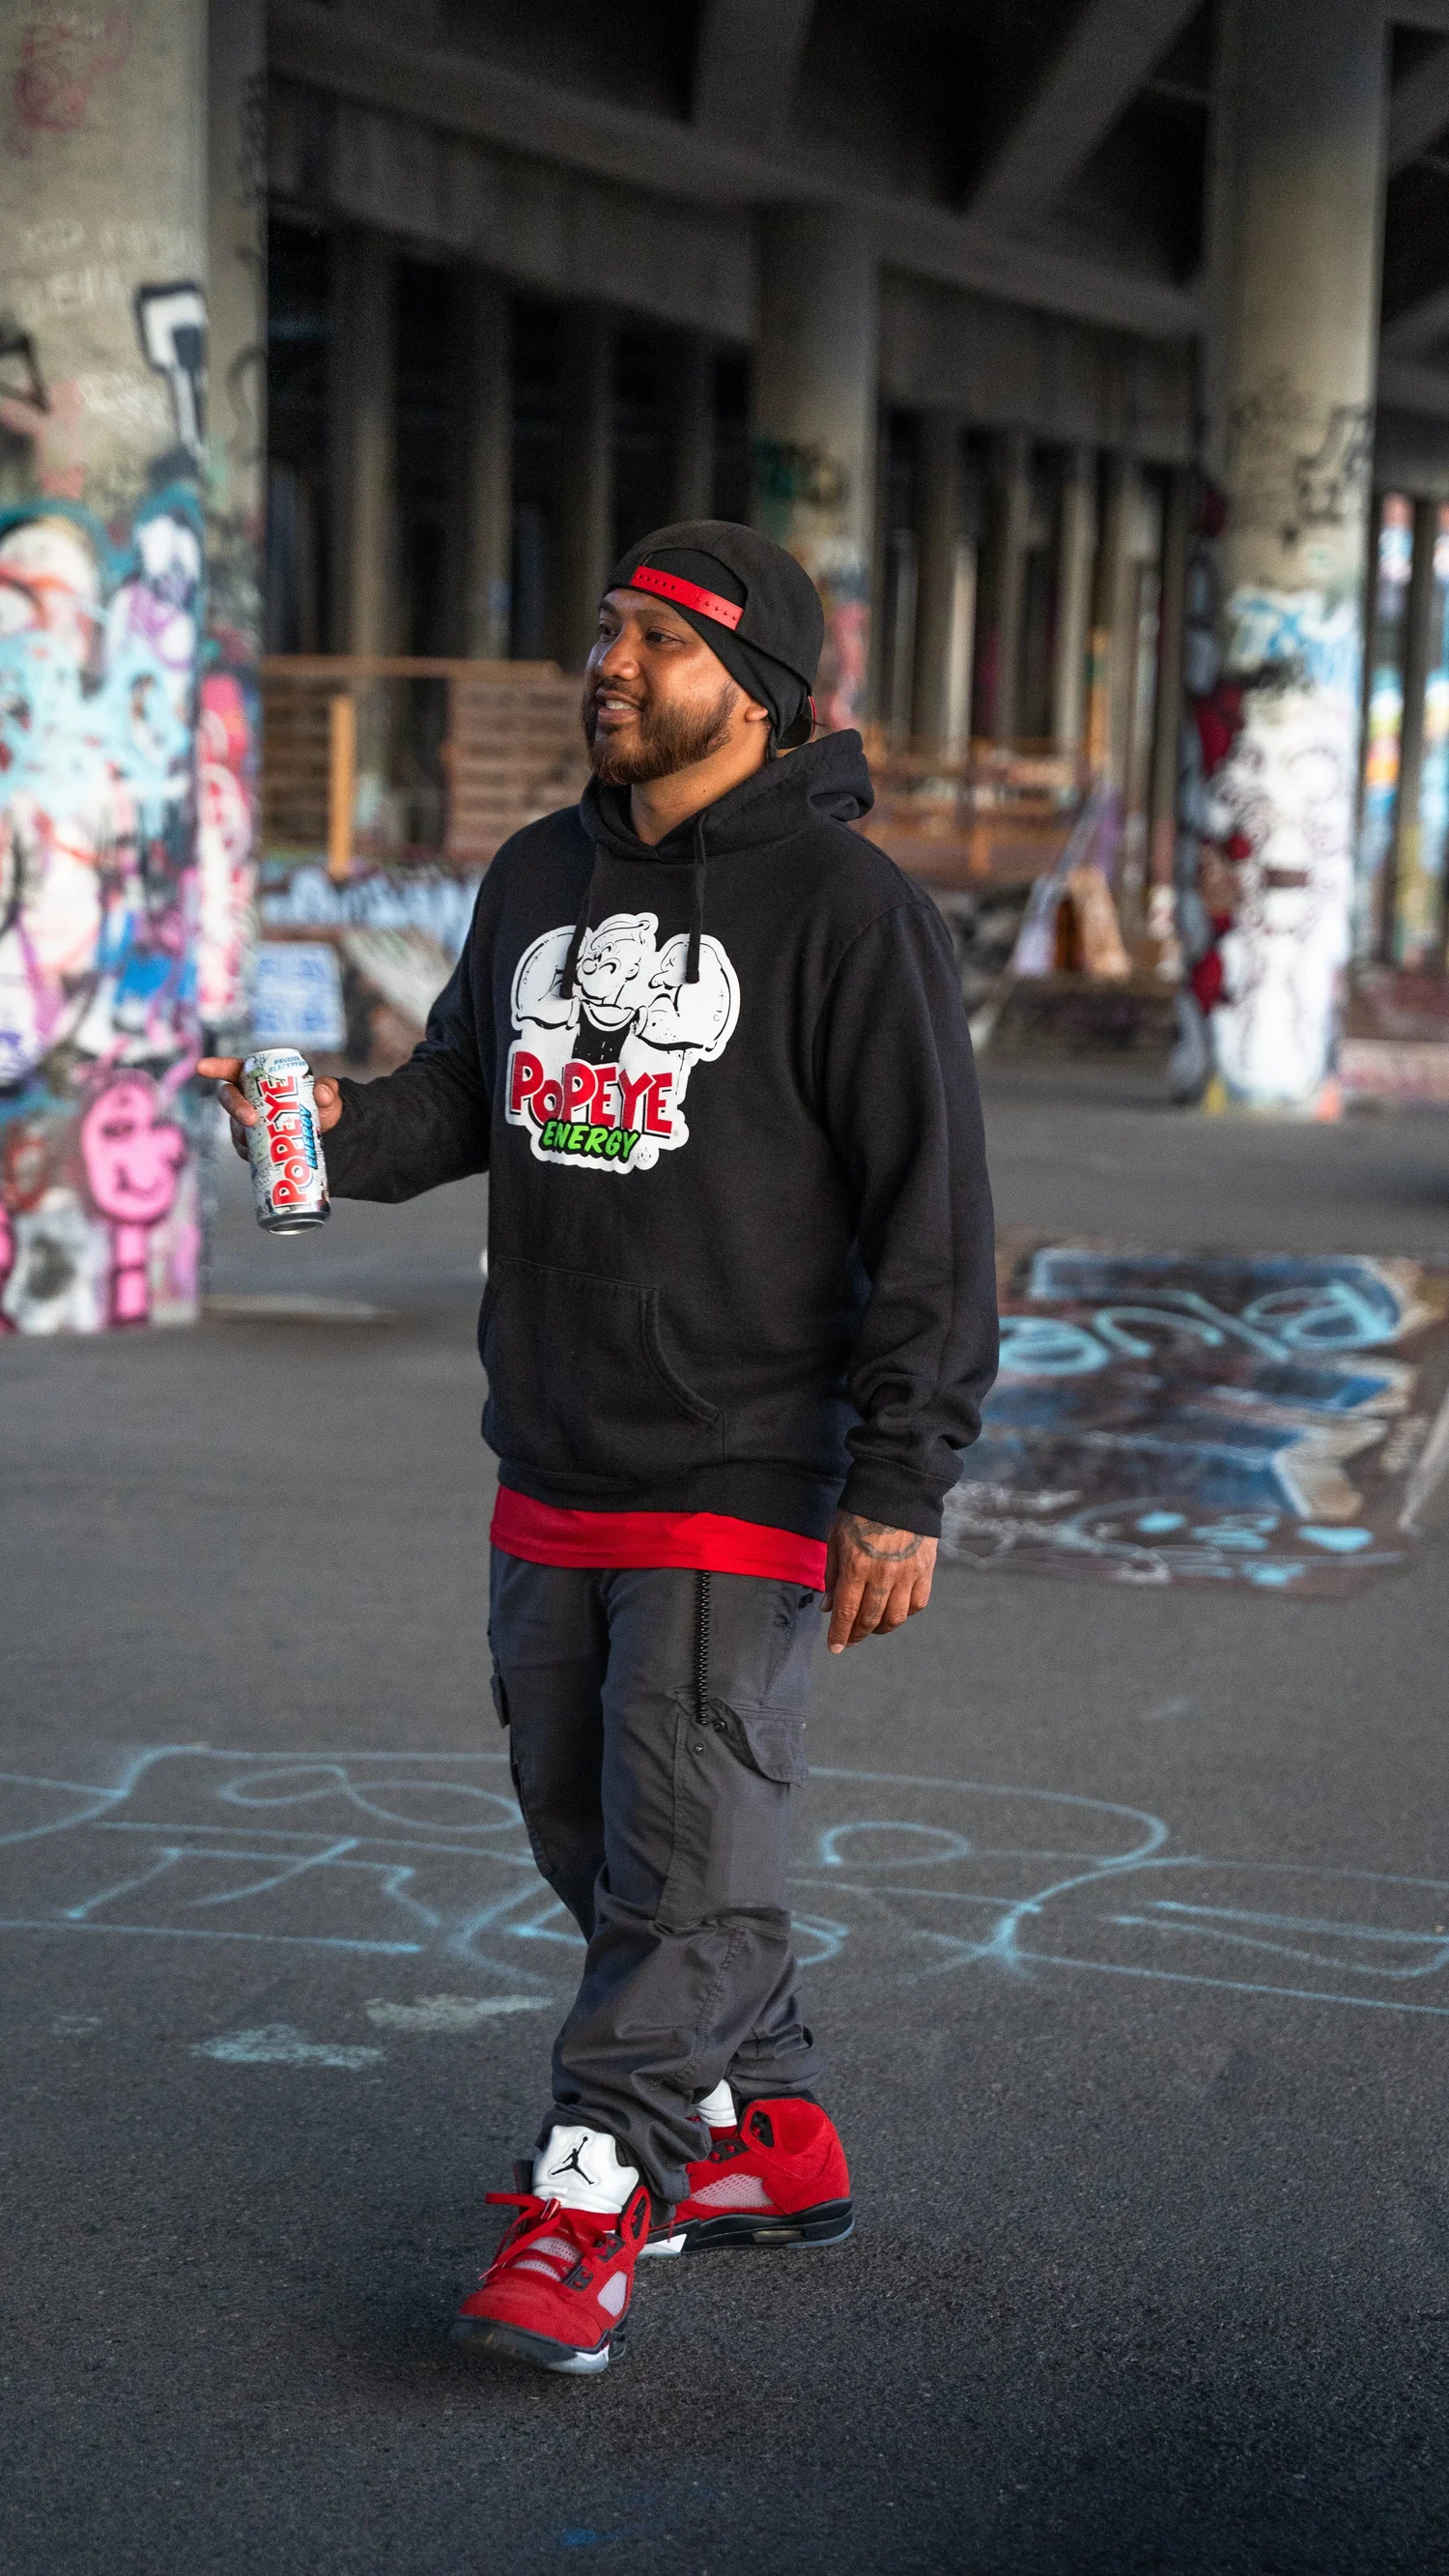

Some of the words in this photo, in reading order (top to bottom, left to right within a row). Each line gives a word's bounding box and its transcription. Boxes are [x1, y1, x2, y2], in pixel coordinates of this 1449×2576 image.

[511, 1050, 673, 1134] POPEYE
[259, 1075, 311, 1206] POPEYE
[298, 1102, 319, 1169] ENERGY
[541, 1121, 639, 1159] ENERGY
